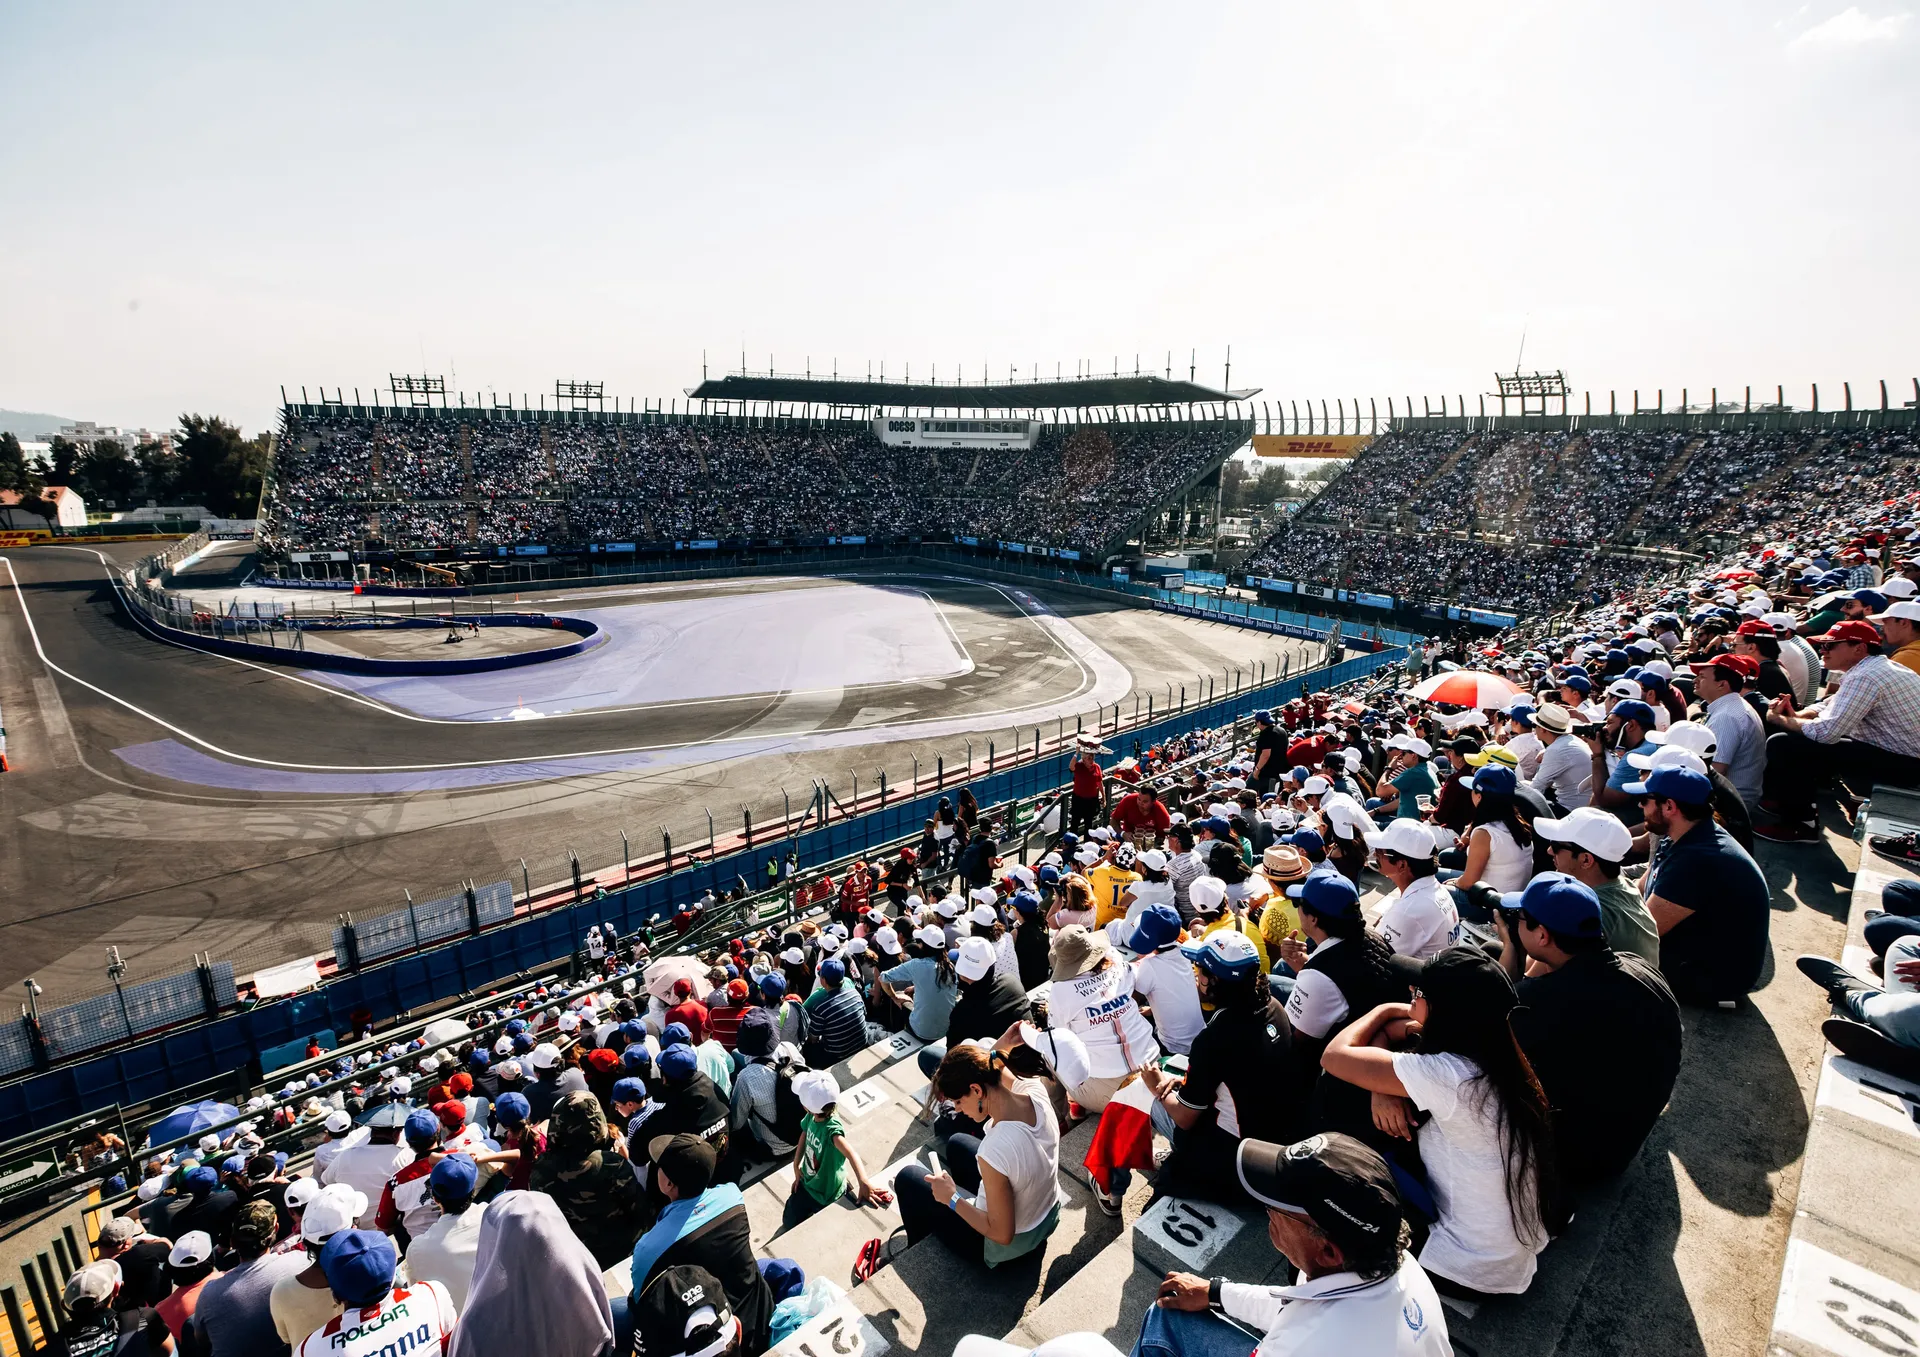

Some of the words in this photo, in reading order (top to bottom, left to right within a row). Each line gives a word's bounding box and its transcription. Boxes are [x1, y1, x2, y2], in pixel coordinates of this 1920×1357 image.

[889, 421, 915, 432] ocesa
[1288, 442, 1337, 453] DHL
[1202, 610, 1217, 619] Julius
[1228, 614, 1244, 624] Julius
[1244, 616, 1254, 626] Bär
[1256, 620, 1272, 630] Julius
[1273, 622, 1283, 631] Bär
[1285, 626, 1302, 636] Julius
[1302, 628, 1314, 637] Bär
[591, 942, 602, 950] 14
[0, 1177, 34, 1193] CUACIÓN
[1162, 1203, 1216, 1247] 19
[1324, 1199, 1365, 1226] ENDURANCE
[1362, 1223, 1380, 1234] 24
[331, 1304, 409, 1349] ROLCAR
